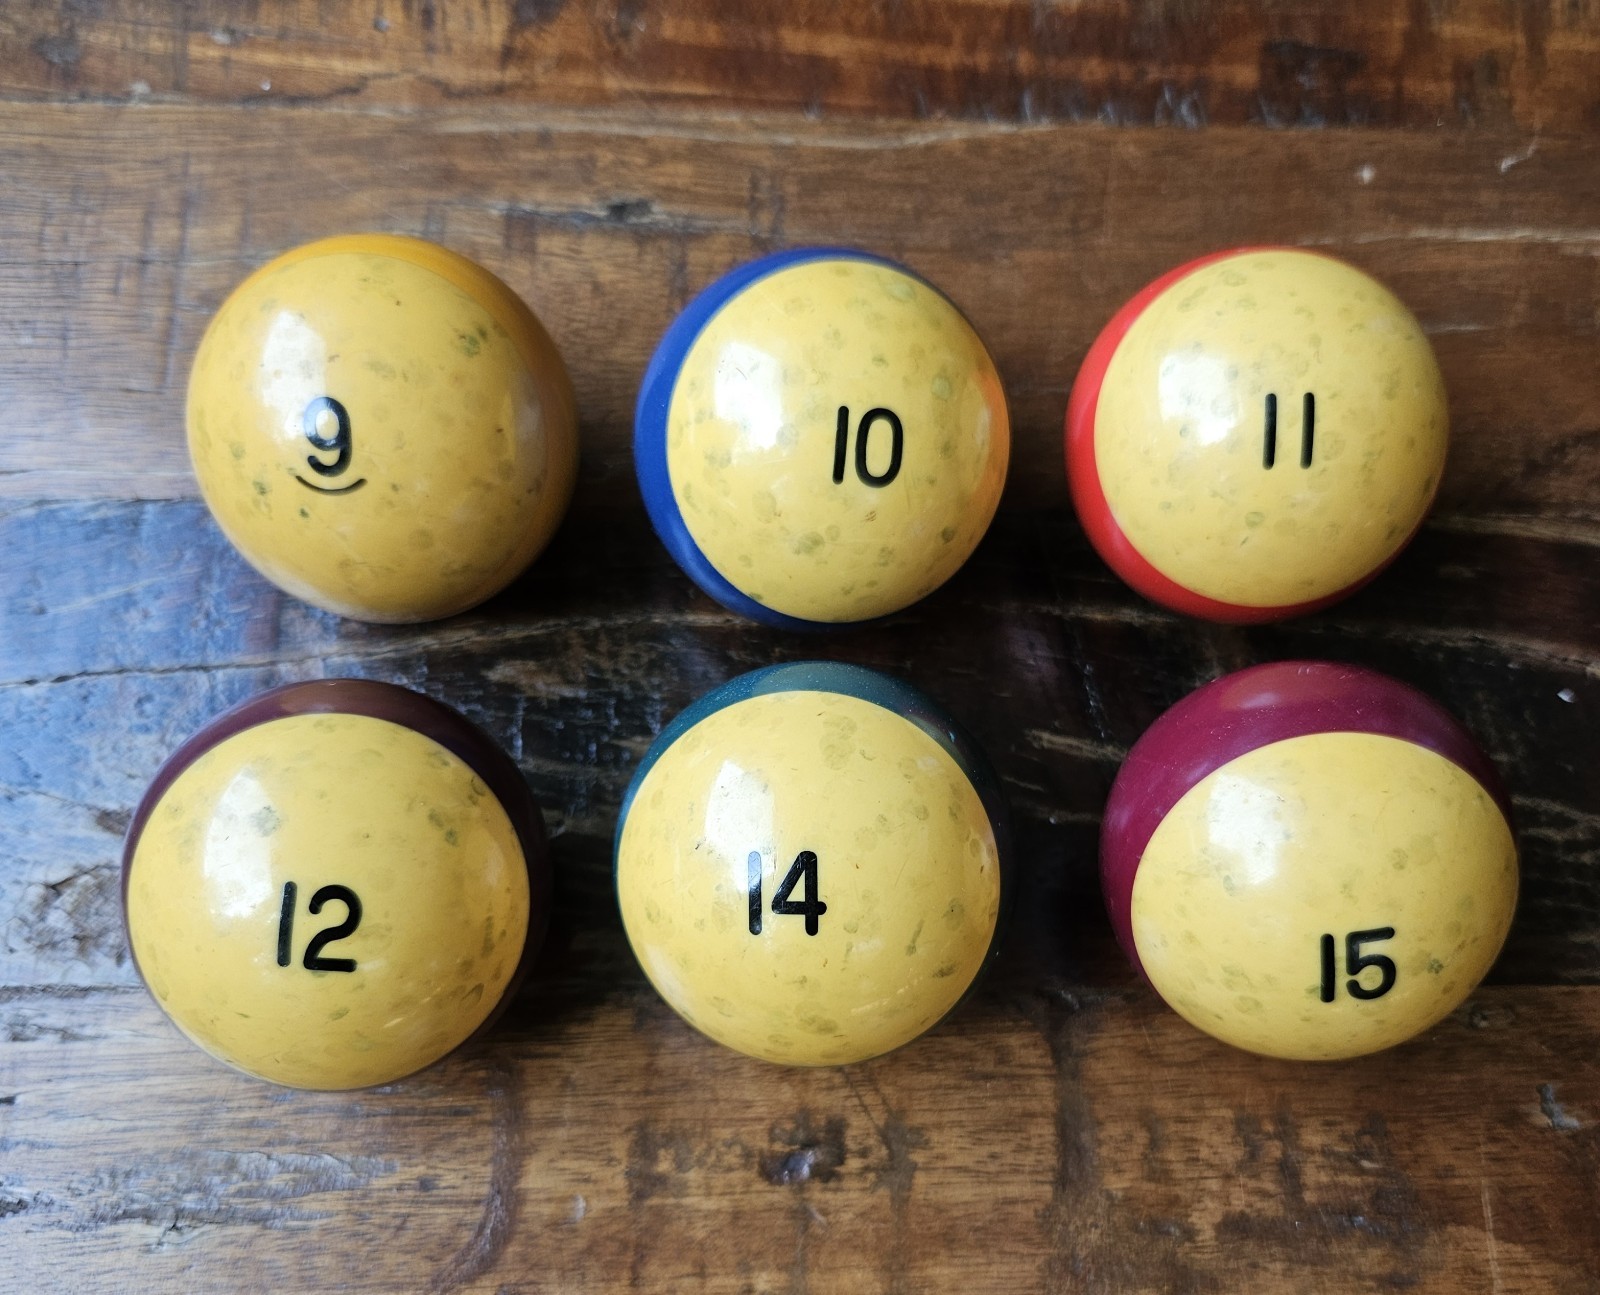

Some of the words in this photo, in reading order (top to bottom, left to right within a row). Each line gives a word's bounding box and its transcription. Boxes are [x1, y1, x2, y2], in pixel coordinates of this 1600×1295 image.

[305, 396, 352, 477] 9
[832, 405, 904, 488] 10
[1264, 392, 1316, 470] 11
[277, 880, 363, 973] 12
[747, 850, 828, 937] 14
[1320, 926, 1397, 1004] 15
